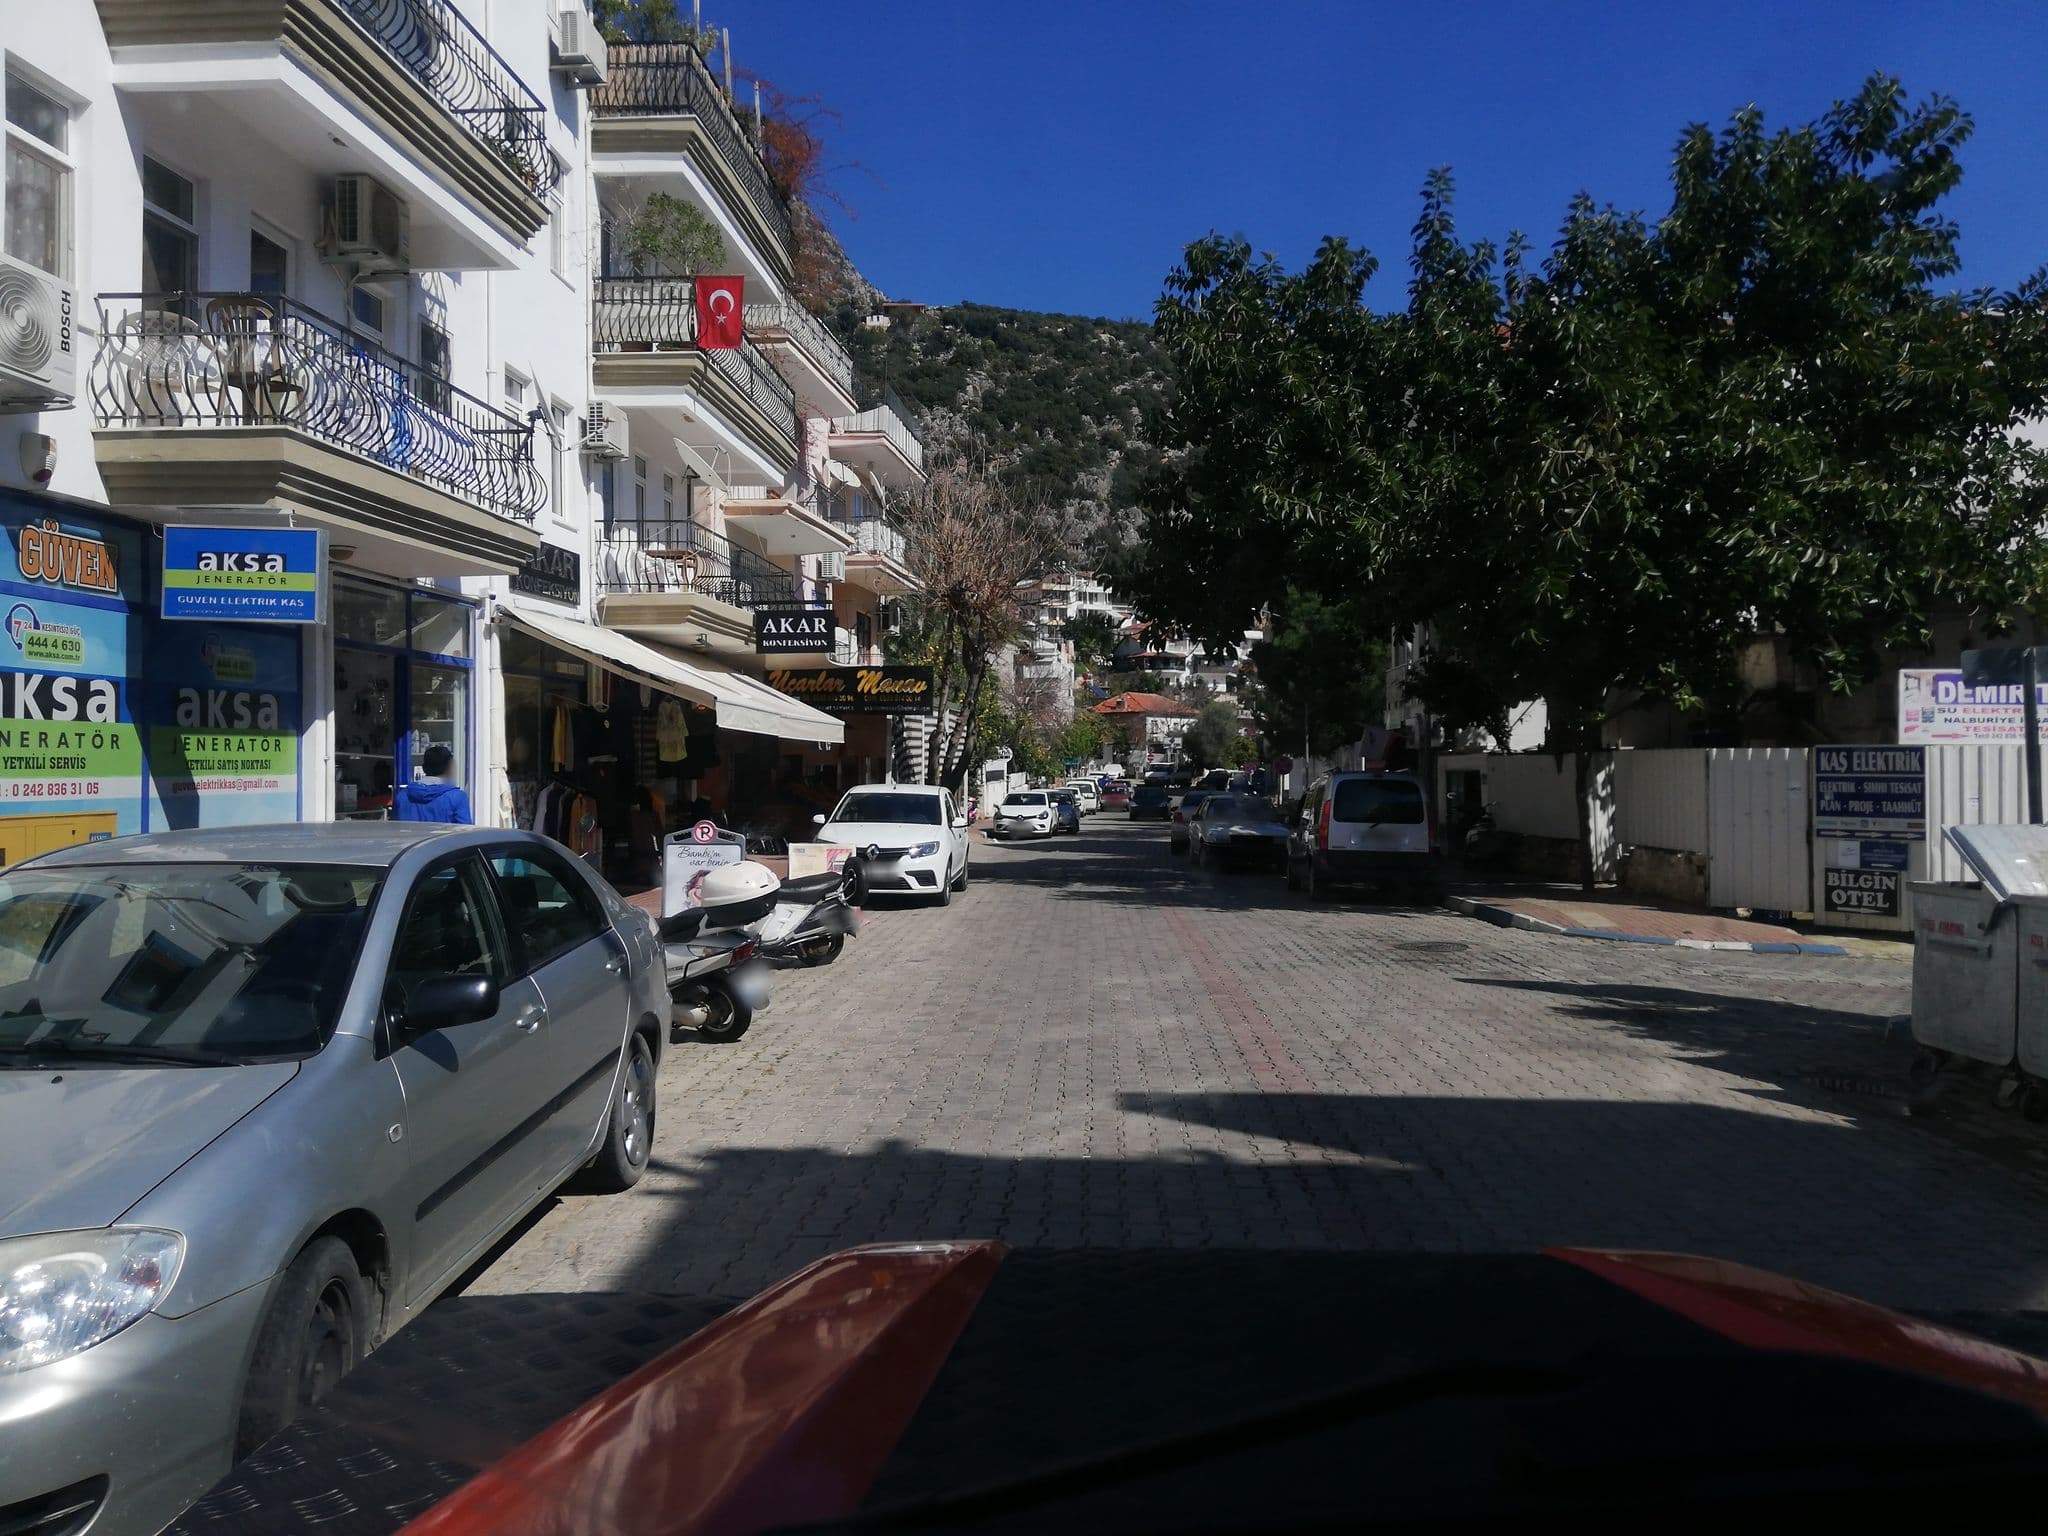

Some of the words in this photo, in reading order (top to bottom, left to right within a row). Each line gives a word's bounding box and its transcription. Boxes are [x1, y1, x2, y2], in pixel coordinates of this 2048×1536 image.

[61, 289, 71, 353] BOSCH
[20, 519, 118, 592] GÜVEN
[199, 552, 284, 573] aksa
[196, 575, 287, 585] JENERATÖR
[762, 617, 828, 634] AKAR
[27, 636, 48, 649] 444
[51, 638, 58, 650] 4
[61, 640, 81, 652] 630
[762, 638, 828, 647] KONFEKSİYON
[0, 672, 116, 723] ksa
[3, 753, 46, 770] YETKİLİ
[50, 753, 87, 770] SERVİS
[1820, 751, 1848, 773] KAŞ
[1852, 750, 1921, 771] ELEKTRİK
[12, 784, 19, 796] 0
[23, 784, 44, 796] 242
[47, 783, 67, 796] 836
[71, 783, 82, 795] 31
[86, 782, 99, 794] 05
[1827, 870, 1897, 890] BİLGİN
[1831, 889, 1890, 908] OTEL
